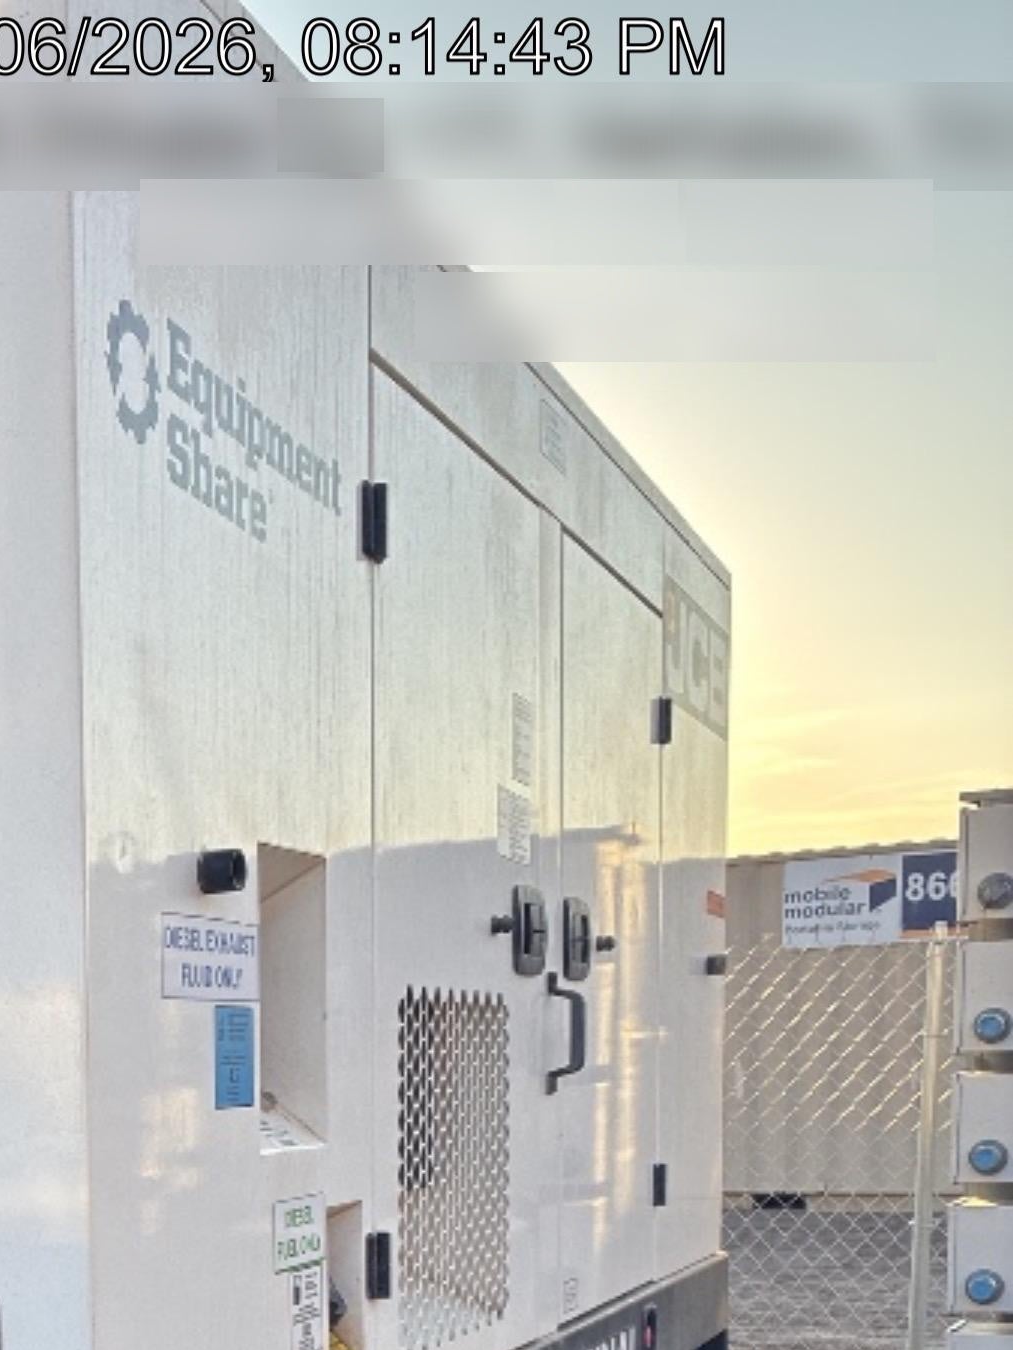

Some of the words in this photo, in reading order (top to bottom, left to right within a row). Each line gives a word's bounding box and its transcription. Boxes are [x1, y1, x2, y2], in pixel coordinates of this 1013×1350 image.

[166, 317, 342, 517] Equipment
[166, 413, 268, 543] Share
[784, 886, 852, 904] mobile
[784, 901, 868, 919] modular
[164, 925, 205, 953] DIESEL
[206, 929, 256, 957] EXHAUST
